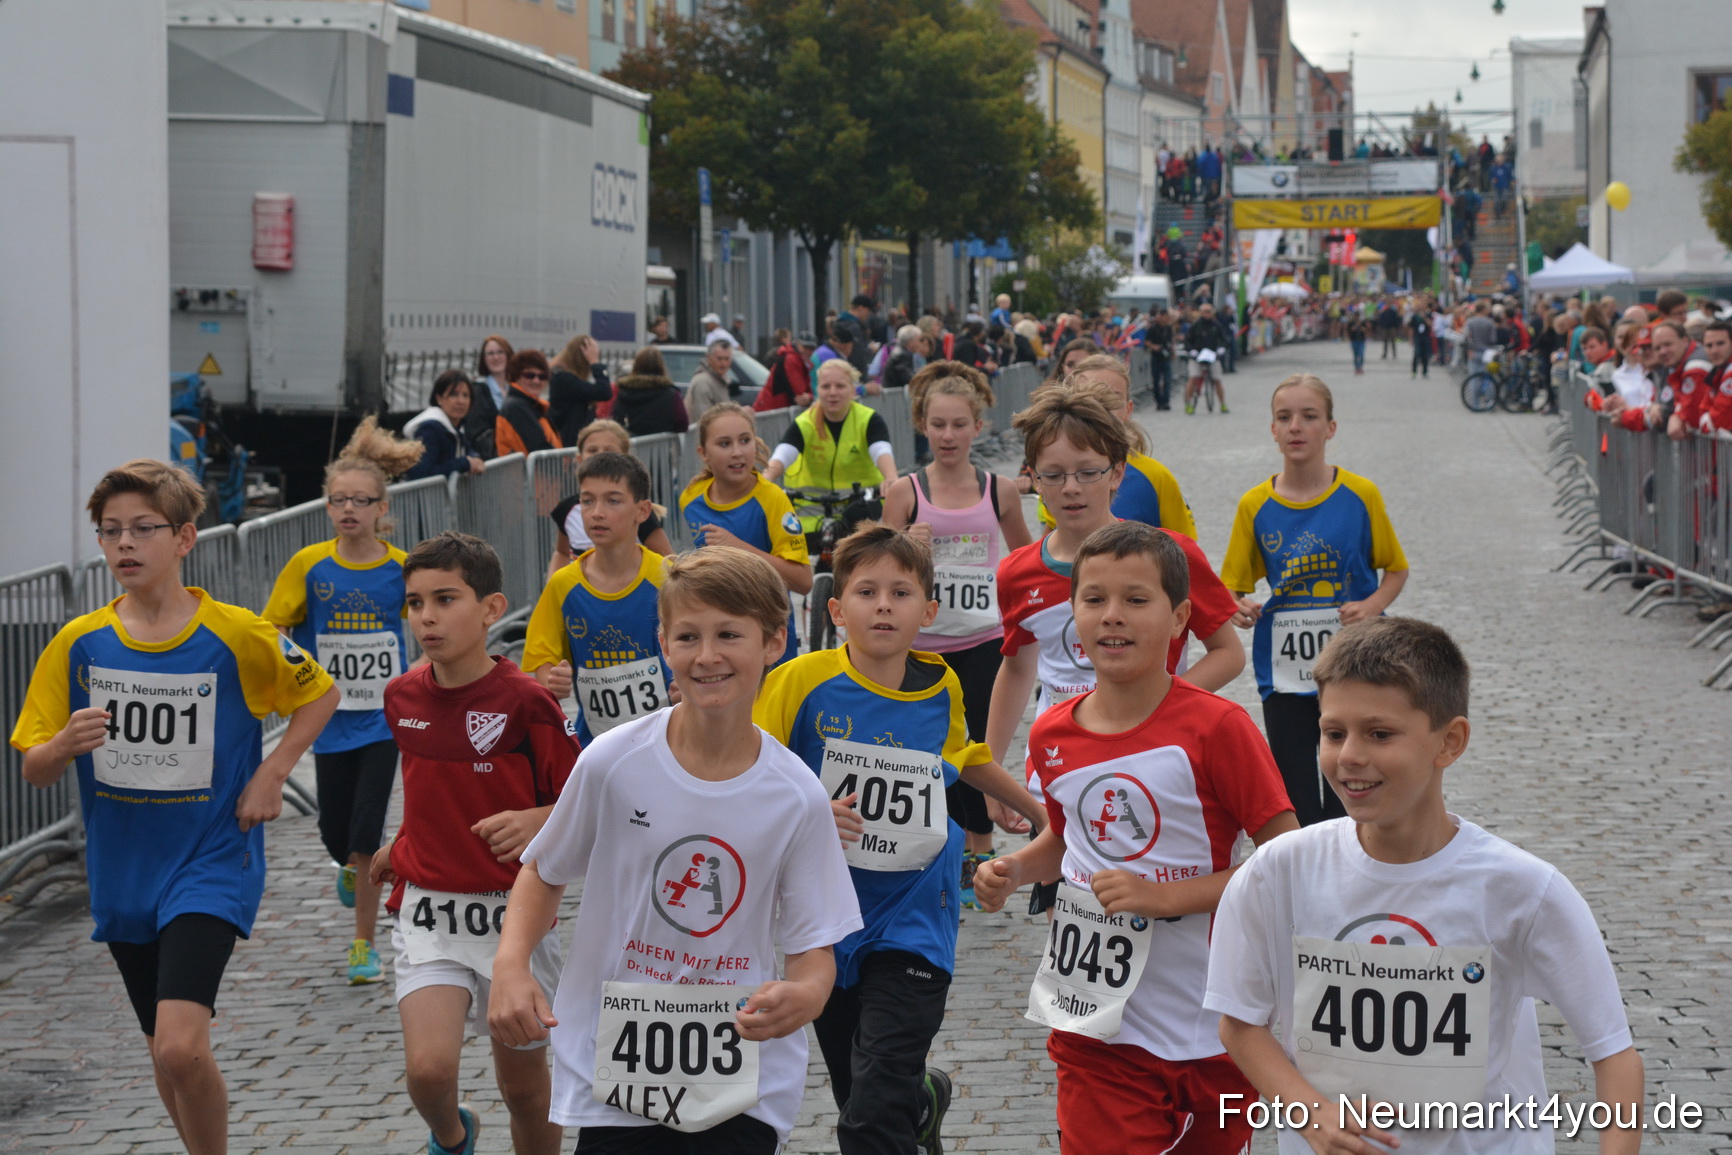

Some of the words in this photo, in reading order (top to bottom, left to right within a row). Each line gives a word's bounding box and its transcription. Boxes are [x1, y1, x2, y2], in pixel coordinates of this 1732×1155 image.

[591, 162, 638, 234] BOCK
[1301, 203, 1372, 222] START
[949, 572, 985, 581] Neumarkt
[1273, 619, 1300, 629] PARTL
[1301, 617, 1340, 627] Neumark
[318, 640, 345, 650] PARTL
[346, 641, 385, 650] Neumarkt
[327, 651, 393, 681] 4029
[91, 678, 129, 694] PARTL
[132, 684, 193, 697] Neumarkt
[577, 676, 601, 686] PARTL
[601, 669, 645, 686] Neumarkt
[346, 688, 374, 701] Katja
[1054, 684, 1089, 694] AUFEN
[589, 680, 660, 719] 4013
[103, 698, 198, 745] 4001
[397, 718, 431, 730] saller
[822, 724, 845, 735] Jahre
[829, 716, 840, 724] 15
[106, 749, 180, 769] JUSTUS
[473, 762, 494, 773] MD
[826, 750, 871, 769] PARTL
[874, 758, 929, 776] Neumarkt
[831, 772, 932, 828] 4051
[629, 817, 650, 828] erima
[860, 833, 898, 855] Max
[1155, 865, 1199, 884] HERZ
[1070, 902, 1124, 927] Neumarkt
[625, 939, 676, 963] AUFEN
[682, 952, 712, 970] MIT
[715, 955, 750, 971] HERZ
[1048, 918, 1133, 989] 4043
[627, 959, 643, 974] Dr.
[645, 965, 674, 982] Heck
[914, 970, 932, 979] JAKO
[1298, 953, 1356, 977] PARTL
[1361, 962, 1455, 981] Neumarkt
[603, 996, 650, 1012] PARTL
[654, 999, 730, 1013] Neumarkt
[1051, 987, 1098, 1017] Joshua
[1311, 984, 1472, 1057] 4004
[611, 1020, 743, 1076] 4003
[605, 1082, 687, 1126] ALEX
